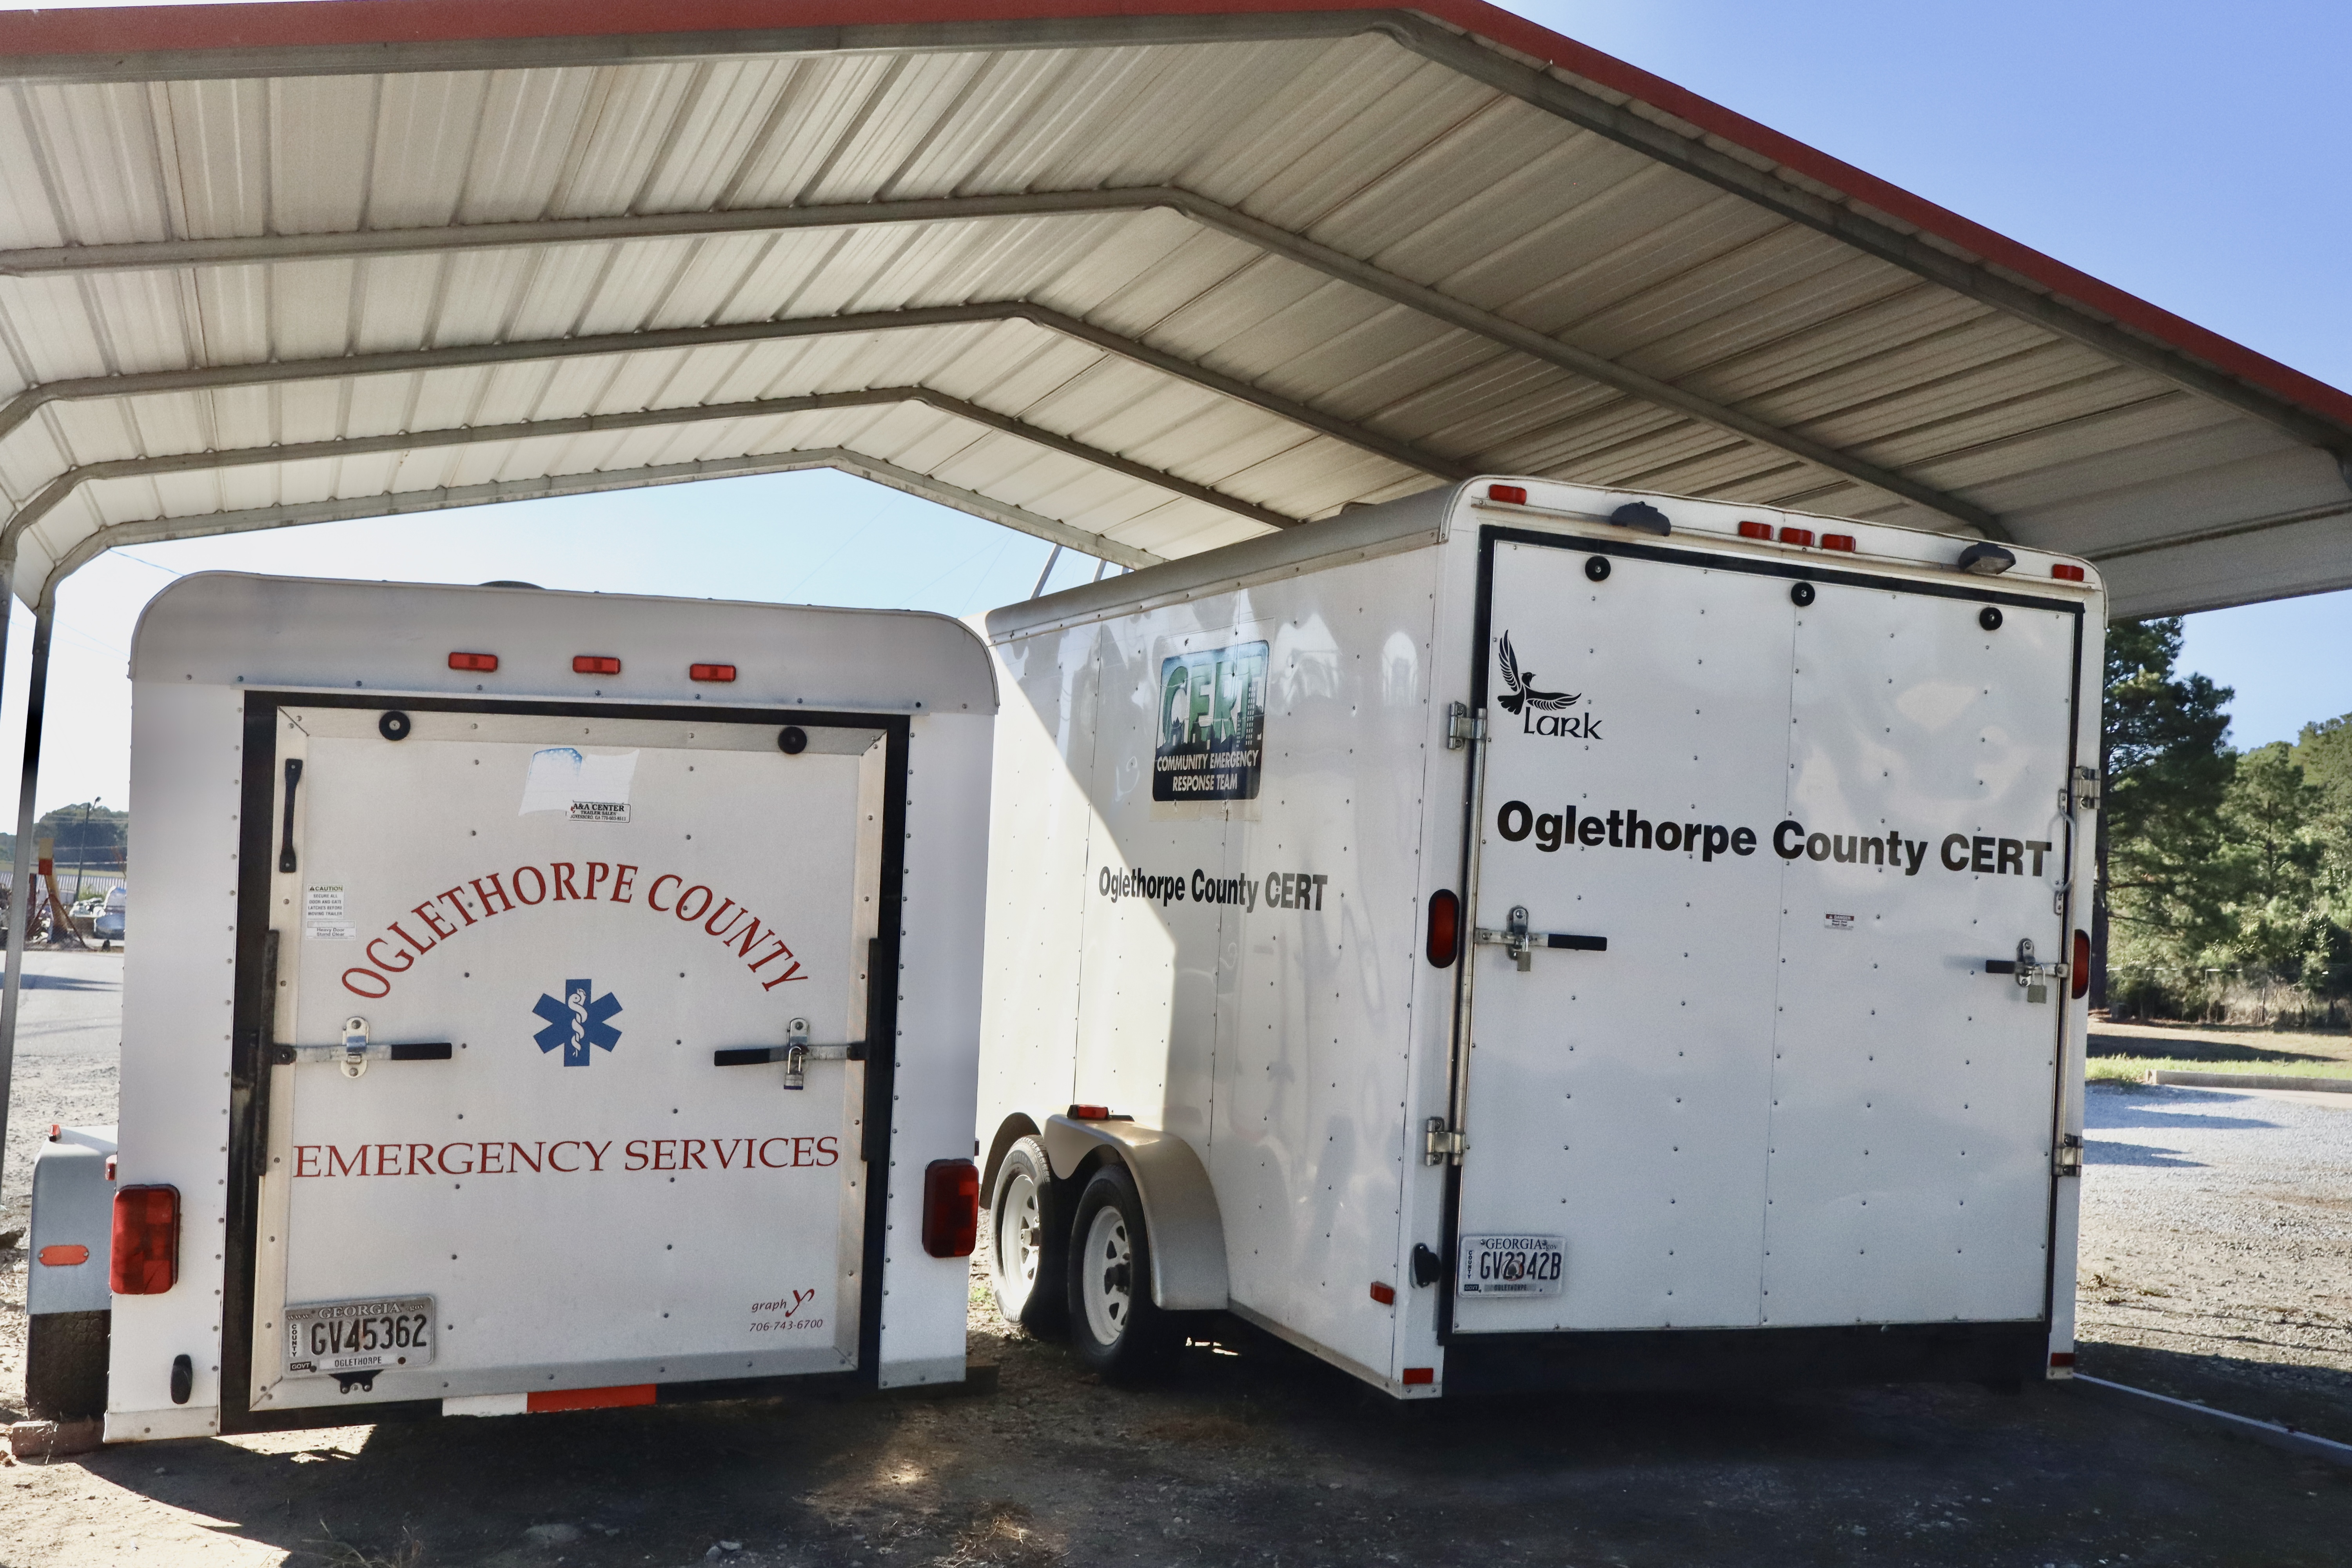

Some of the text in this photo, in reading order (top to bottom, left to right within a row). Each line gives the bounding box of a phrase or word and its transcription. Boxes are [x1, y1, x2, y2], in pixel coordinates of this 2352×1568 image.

[1162, 655, 1262, 744] CERT
[1524, 707, 1603, 740] Lark
[1157, 749, 1259, 772] COMMUNITY EMERGENCY
[1172, 773, 1238, 791] RESPONSE TEAM
[1497, 800, 2052, 877] Oglethorpe County CERT
[1099, 866, 1328, 913] Oglethorpe County CERT
[341, 862, 808, 998] OGLETHORPE COUNTY
[293, 1137, 838, 1178] EMERGENCY SERVICES
[1480, 1251, 1562, 1279] GV2342B
[318, 1303, 401, 1319] GEORGIA
[750, 1319, 823, 1332] 706-743-6700
[311, 1314, 427, 1355] GV45362
[335, 1356, 382, 1367] OGLETHORPE
